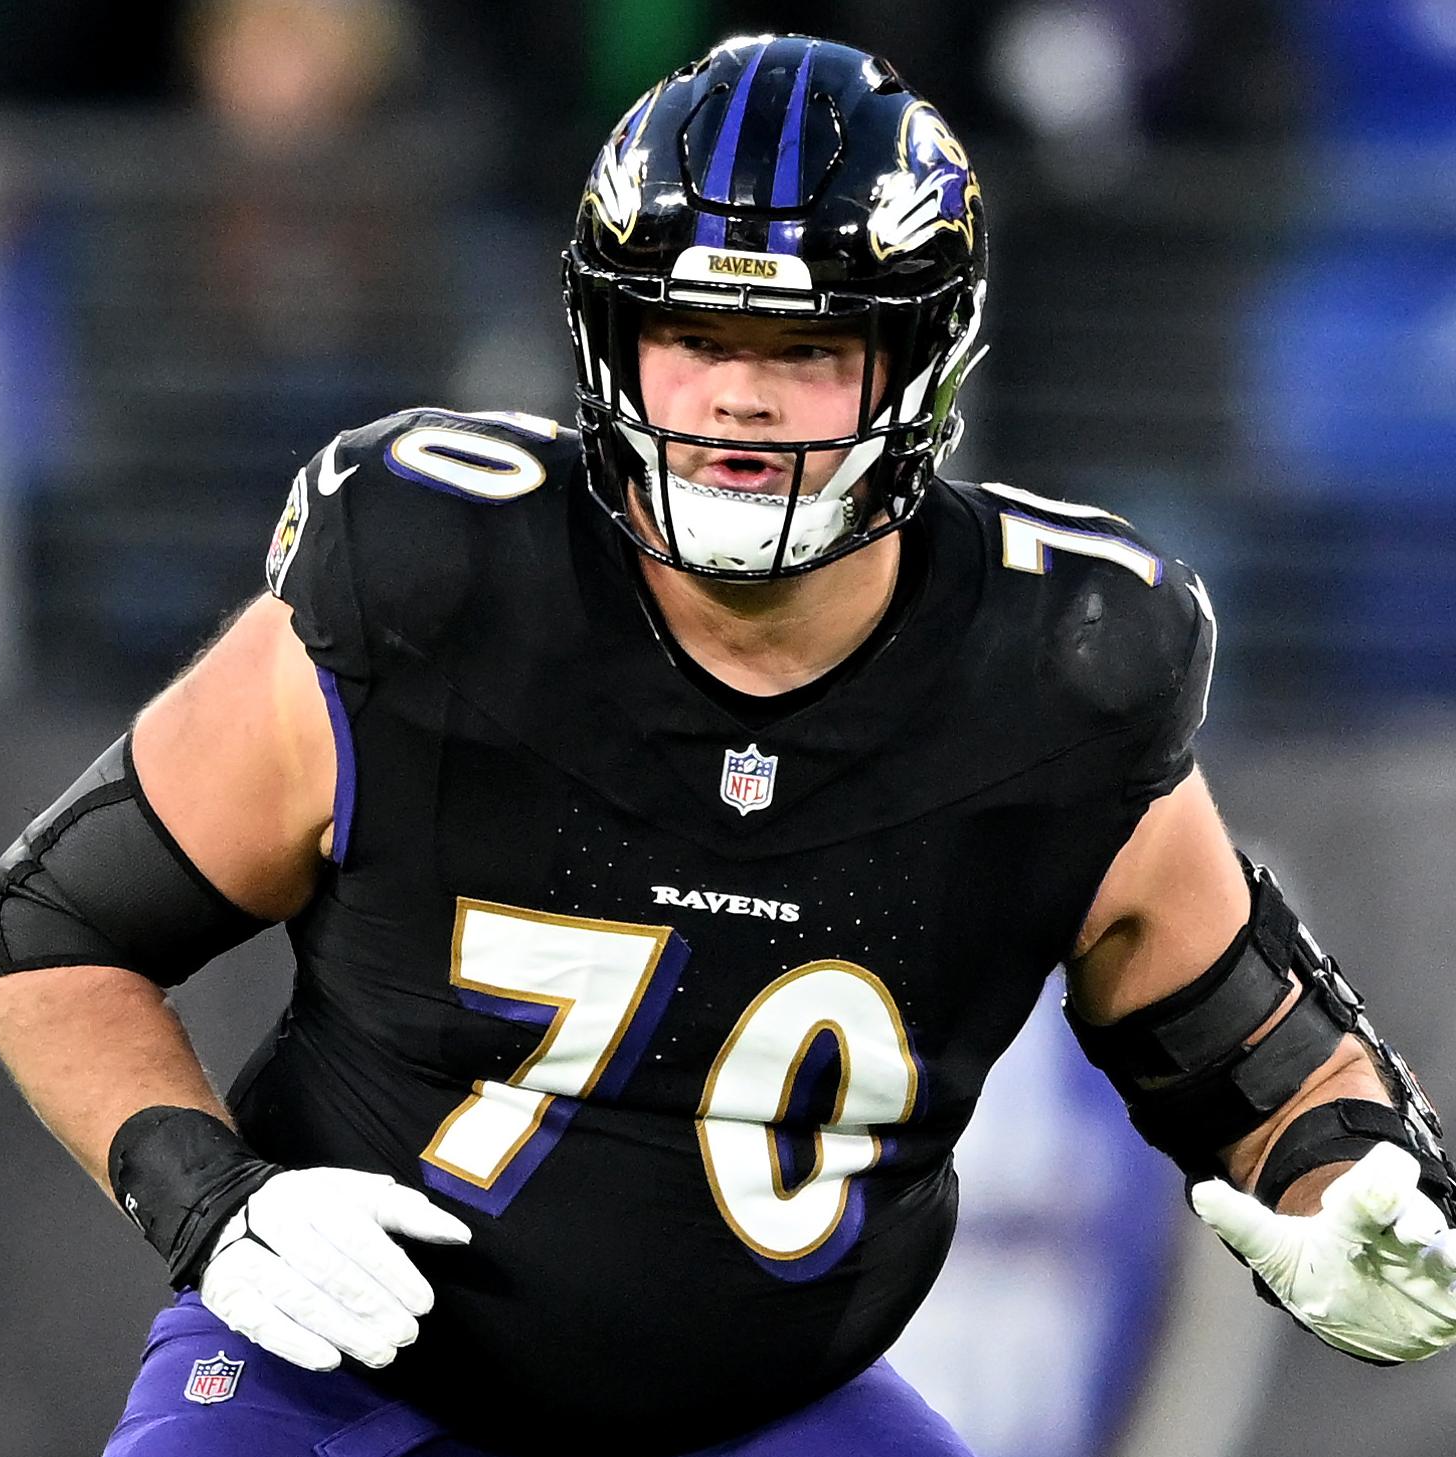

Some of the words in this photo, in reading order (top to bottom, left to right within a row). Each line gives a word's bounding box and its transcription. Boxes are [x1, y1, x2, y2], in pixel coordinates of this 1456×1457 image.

[708, 255, 778, 278] RAVENS
[729, 774, 764, 801] NFL
[651, 885, 800, 923] RAVENS
[420, 896, 926, 1280] 70
[194, 1376, 229, 1396] NFL
